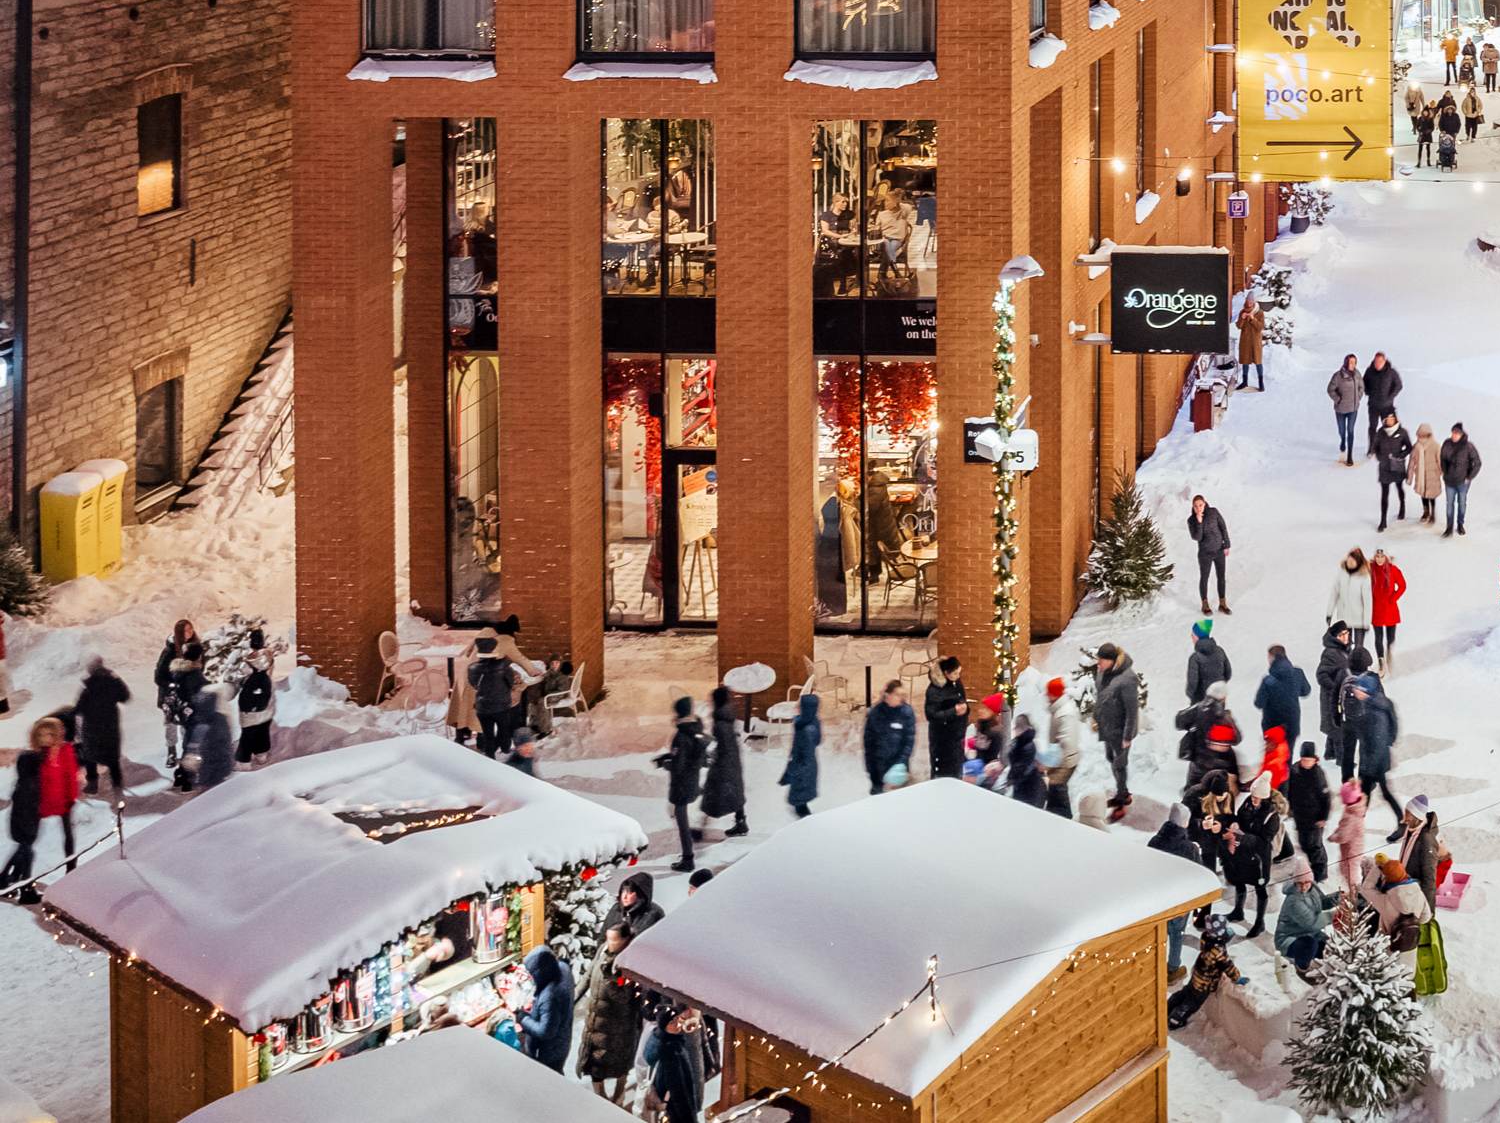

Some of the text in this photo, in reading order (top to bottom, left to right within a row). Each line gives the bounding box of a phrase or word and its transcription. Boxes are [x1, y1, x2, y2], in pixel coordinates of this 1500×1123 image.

[1265, 84, 1364, 107] poco.art
[906, 331, 919, 339] on
[1015, 450, 1025, 463] 5
